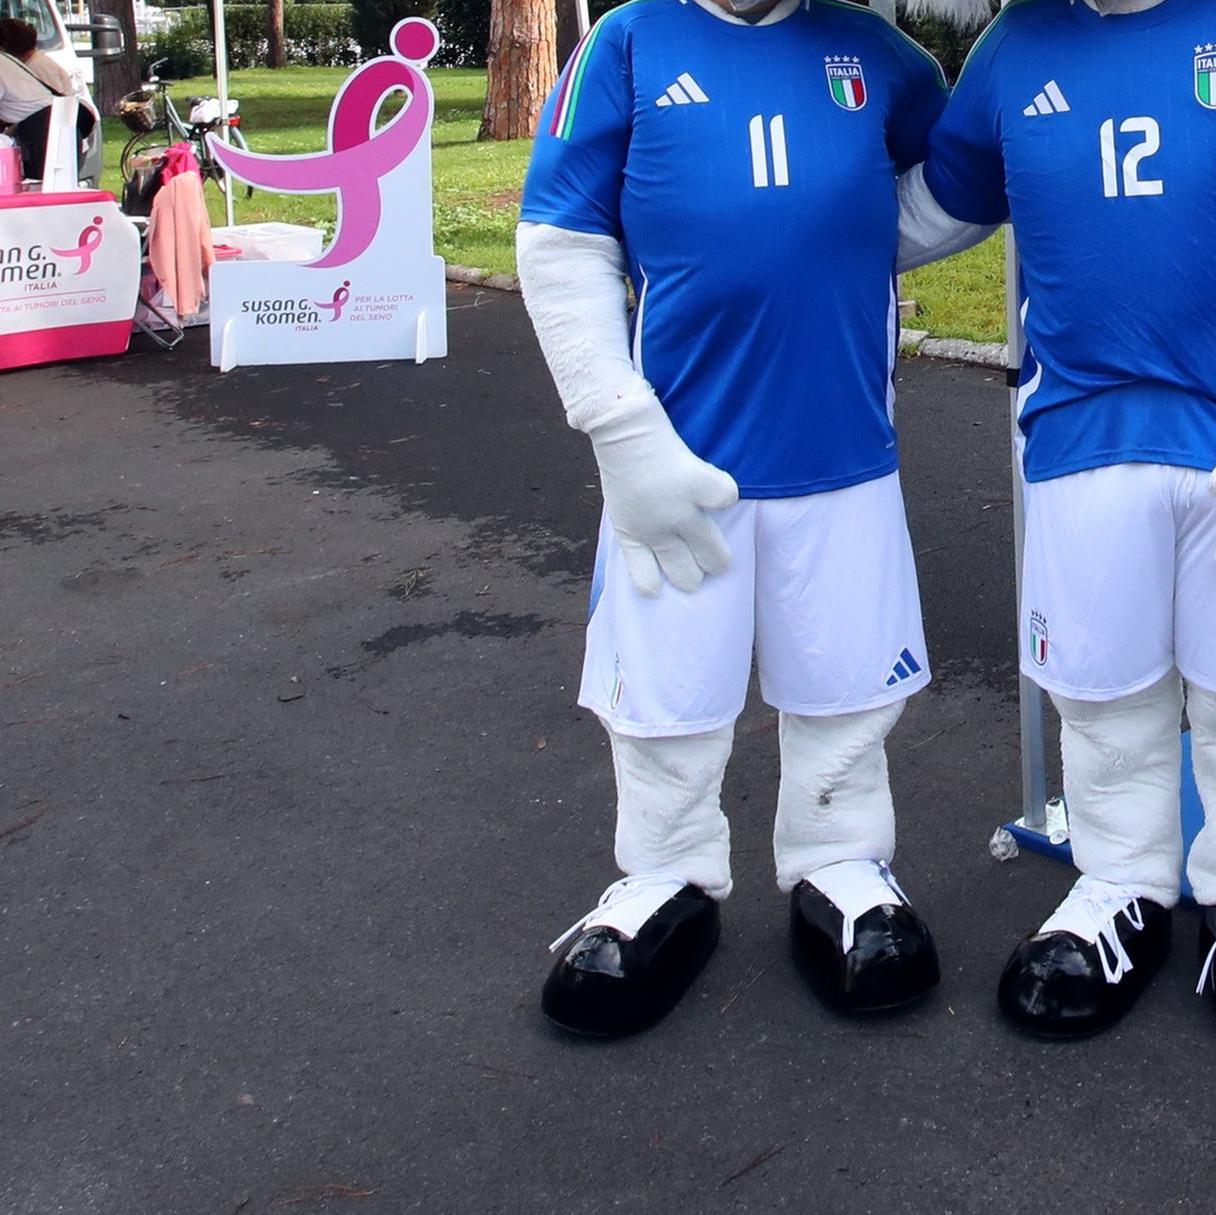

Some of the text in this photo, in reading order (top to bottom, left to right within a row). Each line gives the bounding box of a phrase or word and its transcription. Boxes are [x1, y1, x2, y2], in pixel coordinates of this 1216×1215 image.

[829, 67, 860, 76] ITALIA
[749, 114, 790, 187] 11
[1099, 116, 1164, 198] 12
[24, 281, 58, 291] ITALIA
[25, 299, 60, 310] TUMORI
[61, 298, 78, 306] DEL
[80, 295, 107, 305] SENO
[387, 294, 414, 302] LOTTA
[365, 304, 399, 312] TUMORI
[368, 313, 393, 321] SENO
